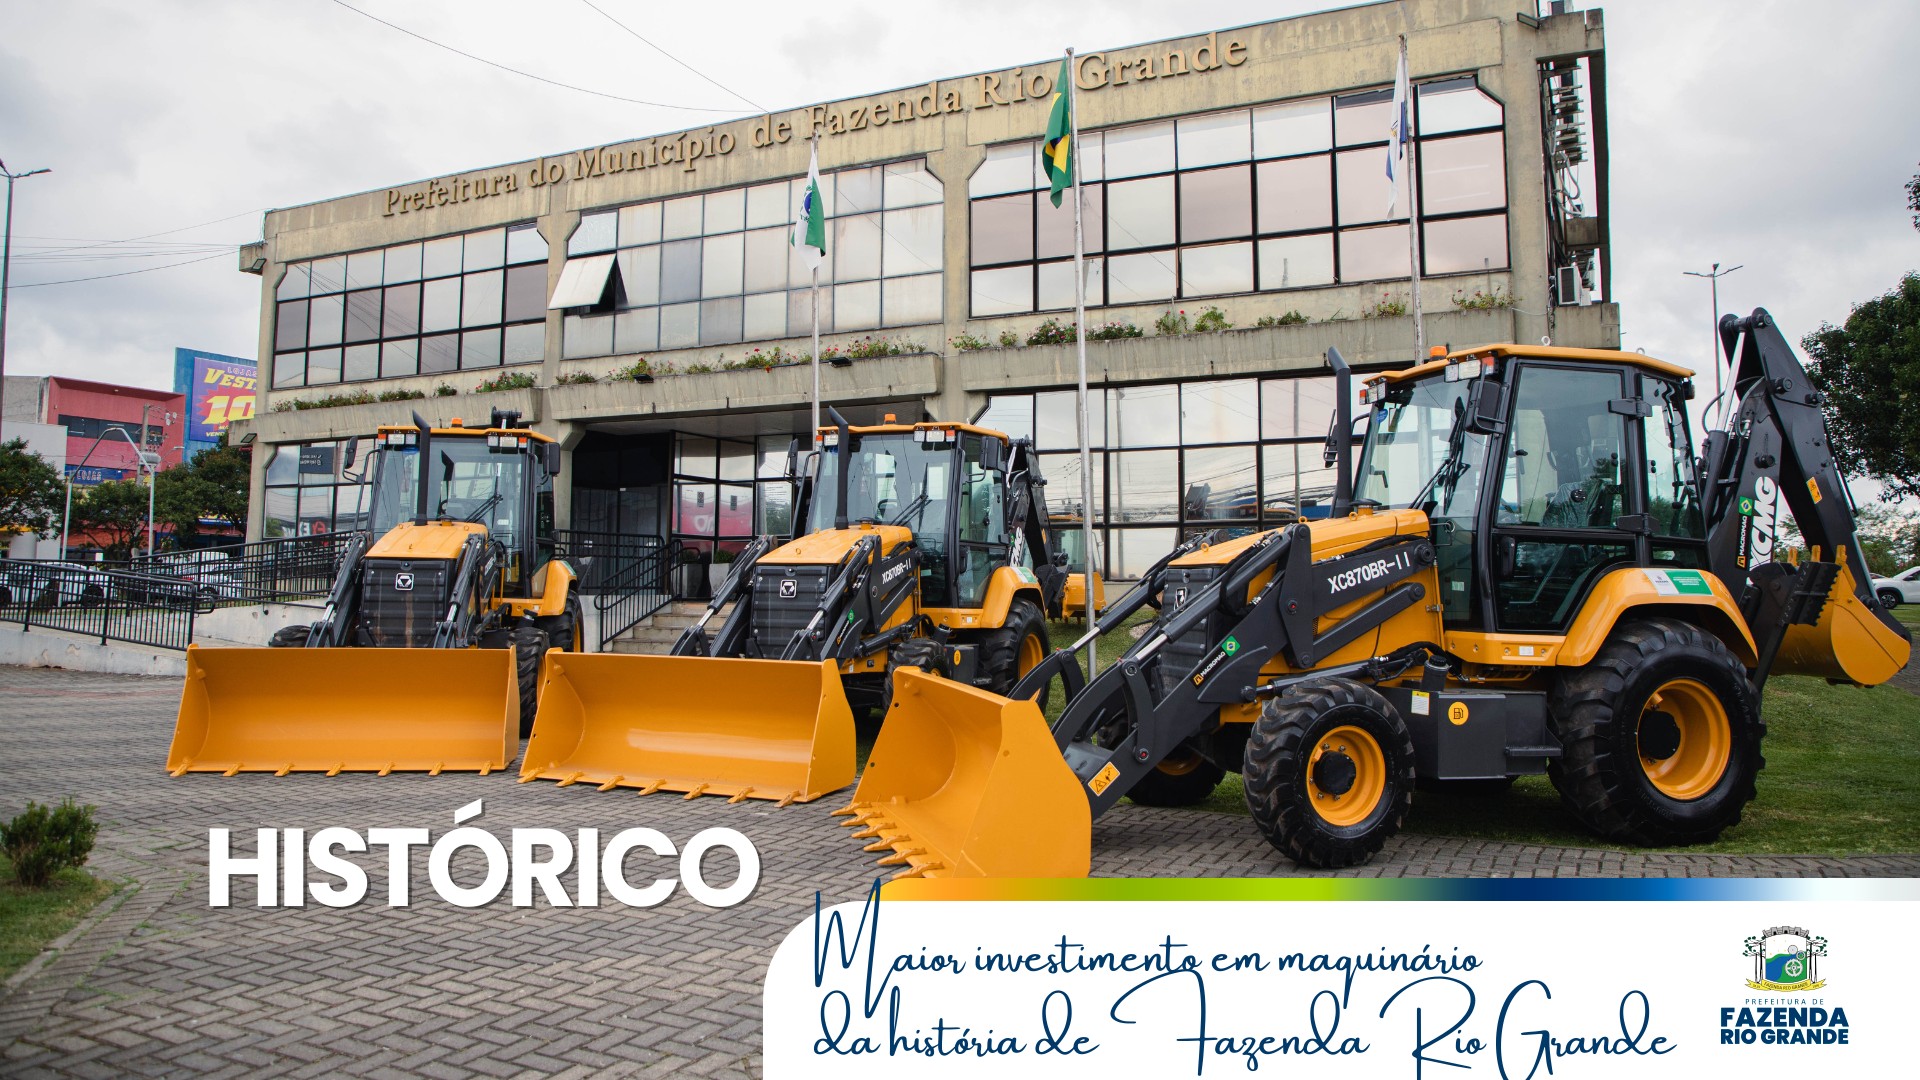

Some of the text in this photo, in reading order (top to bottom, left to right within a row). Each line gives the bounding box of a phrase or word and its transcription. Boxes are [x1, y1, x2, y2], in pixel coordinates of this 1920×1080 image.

[382, 32, 1248, 217] Prefeitura do Município de Fazenda Rio Grande
[203, 368, 257, 390] VEST
